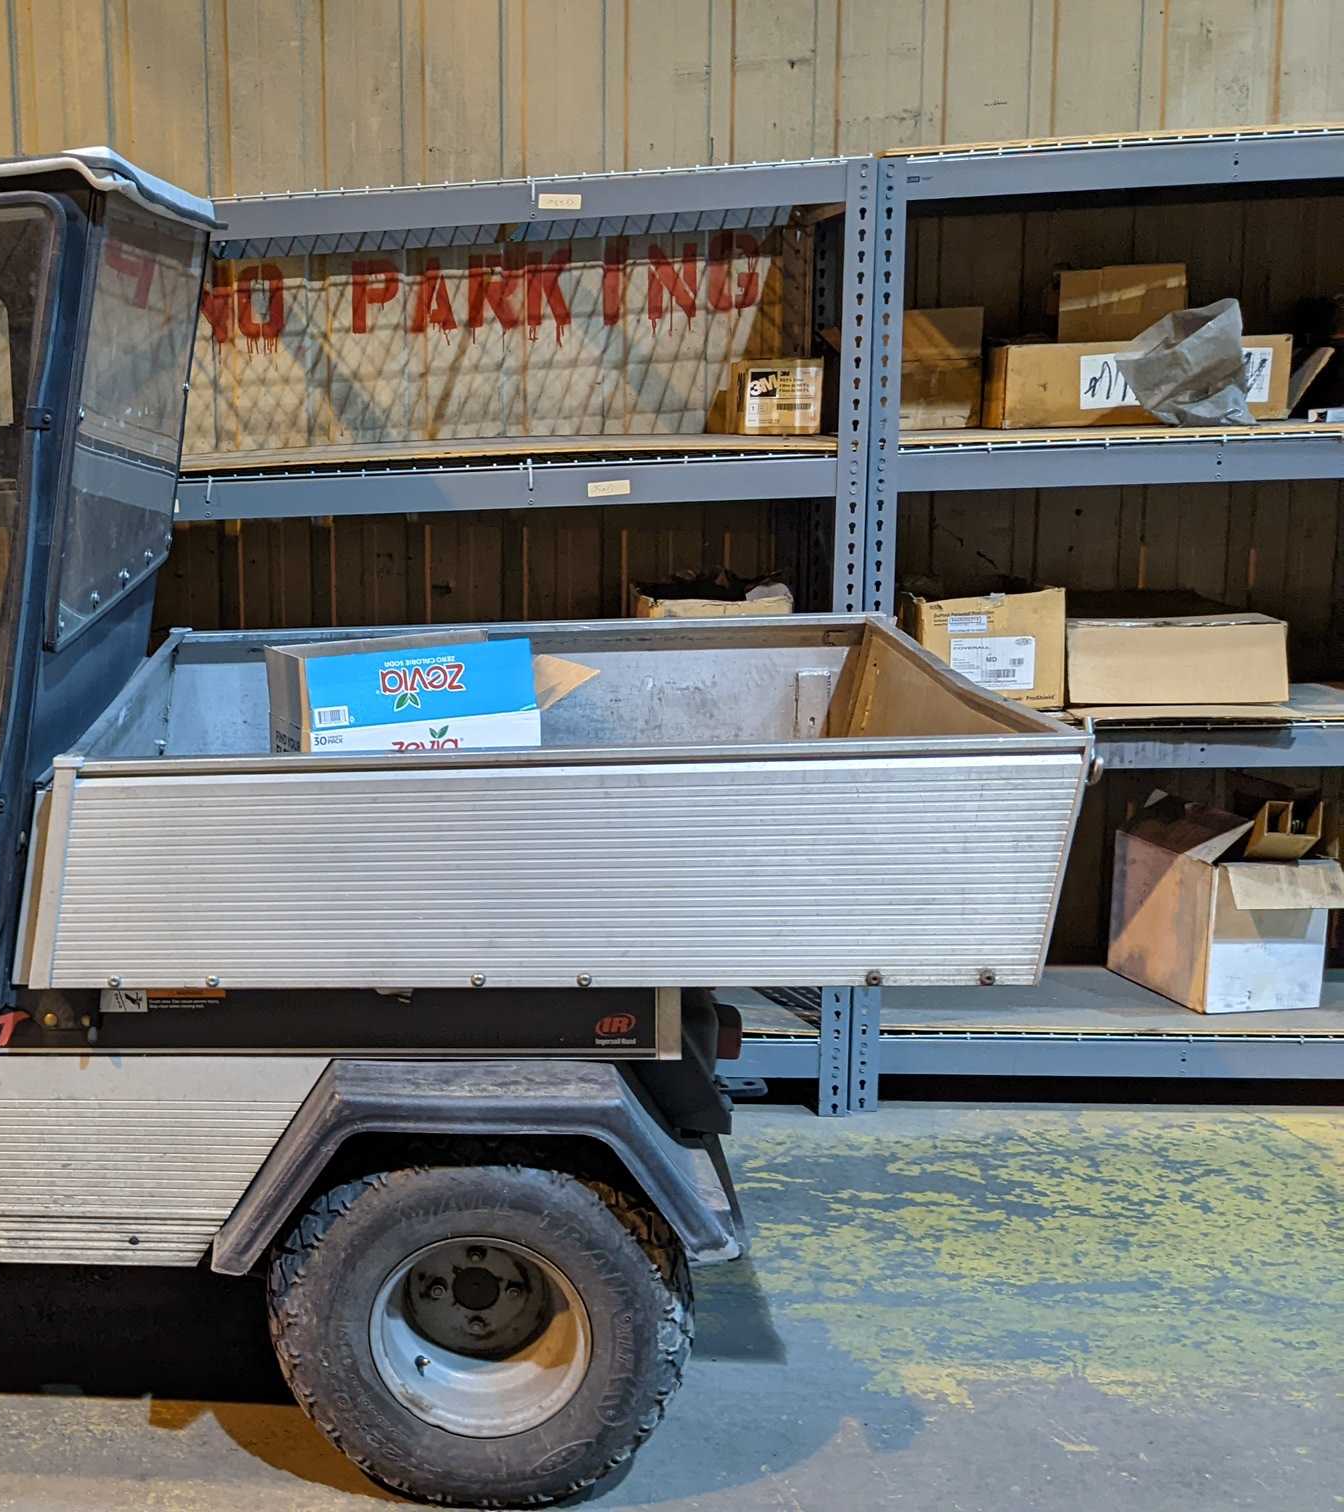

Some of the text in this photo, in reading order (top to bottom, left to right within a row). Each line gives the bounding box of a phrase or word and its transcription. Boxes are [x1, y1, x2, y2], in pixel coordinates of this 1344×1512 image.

[351, 232, 760, 336] PARKING
[751, 374, 777, 396] 3M
[384, 655, 456, 668] ZERO CALORIE SODA
[380, 663, 465, 695] zevia
[314, 736, 327, 746] 30
